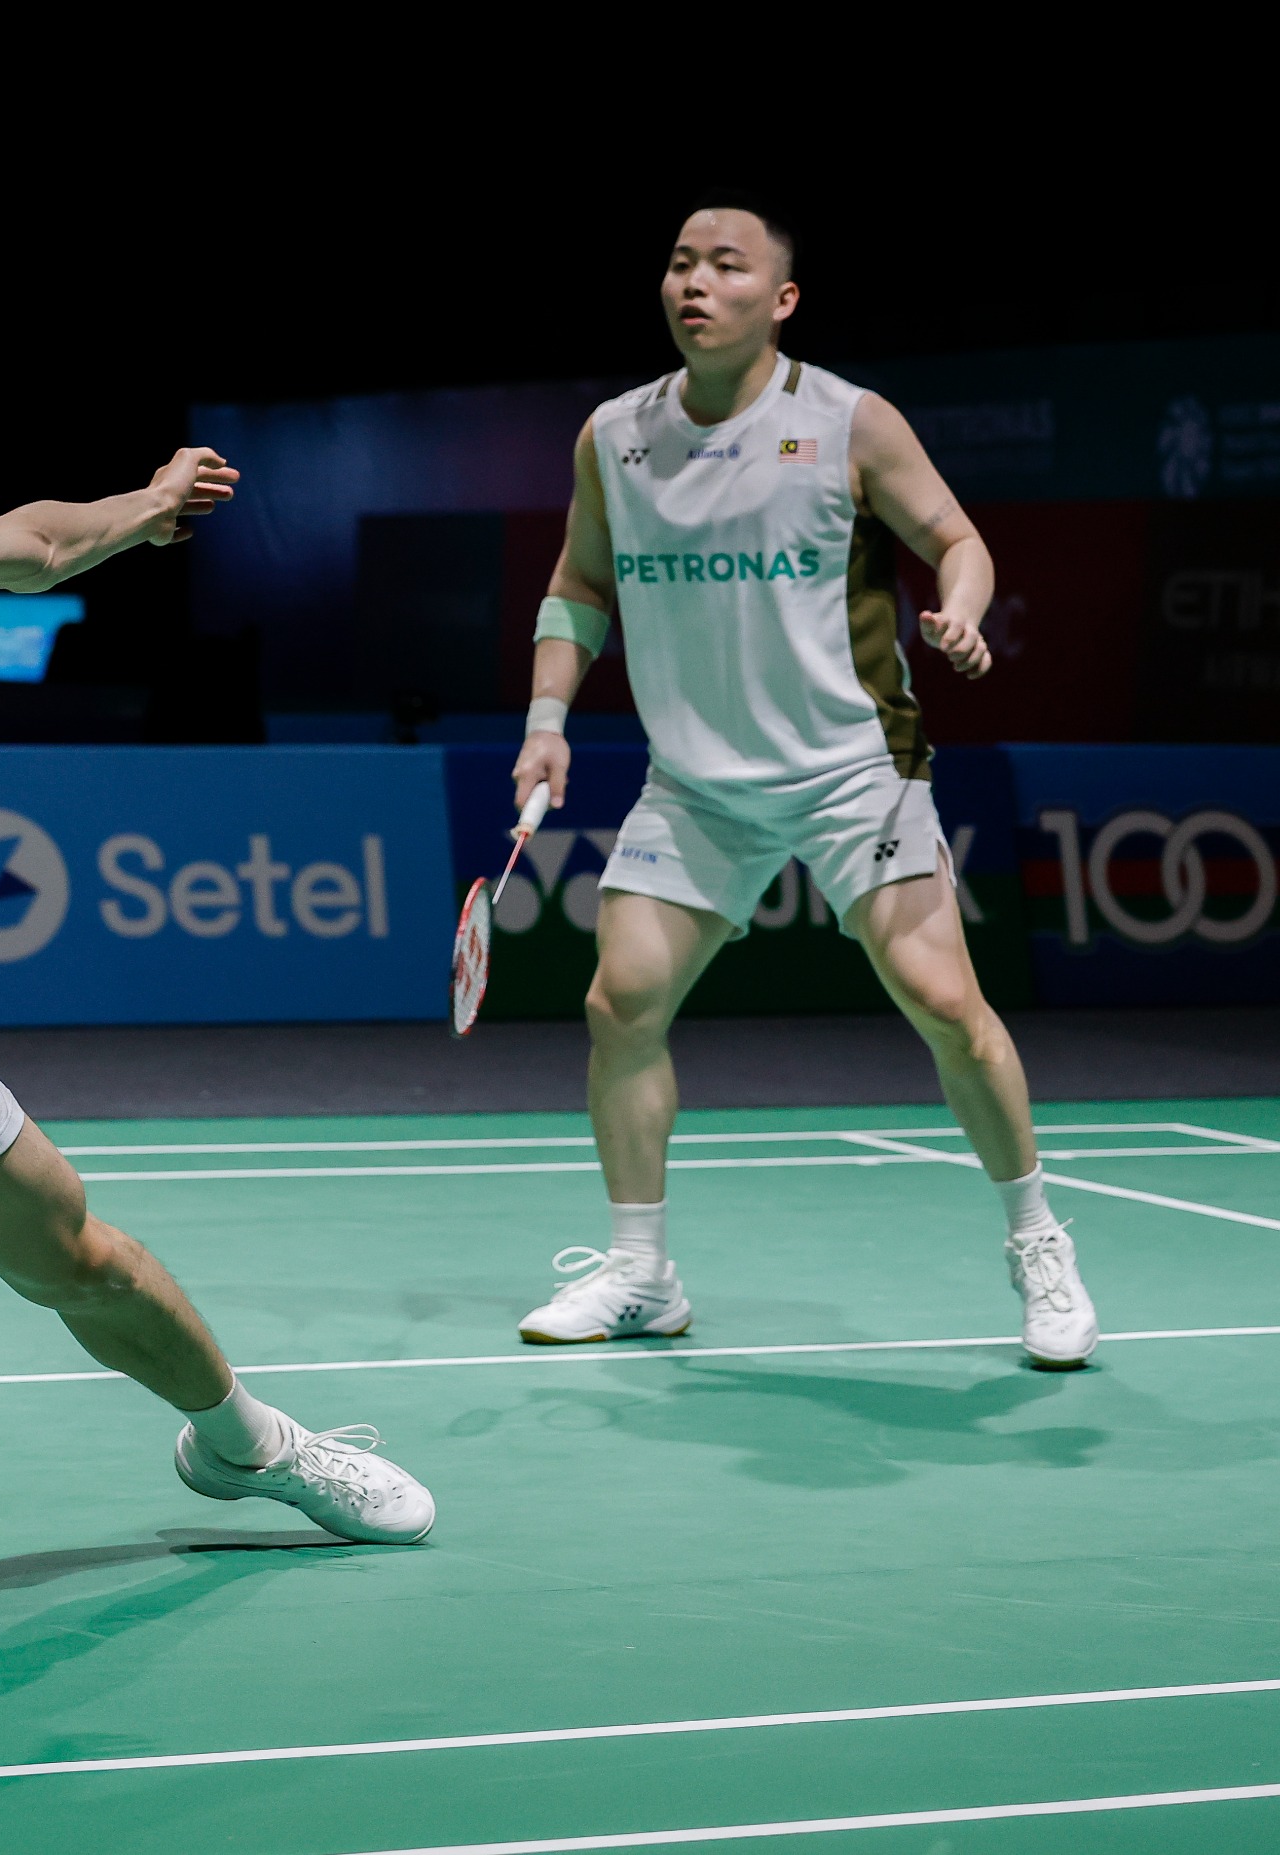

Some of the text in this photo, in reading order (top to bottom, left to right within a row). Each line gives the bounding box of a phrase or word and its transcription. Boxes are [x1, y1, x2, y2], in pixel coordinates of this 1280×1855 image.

[617, 550, 821, 583] PETRONAS
[97, 833, 388, 939] Setel
[1040, 810, 1277, 944] 100
